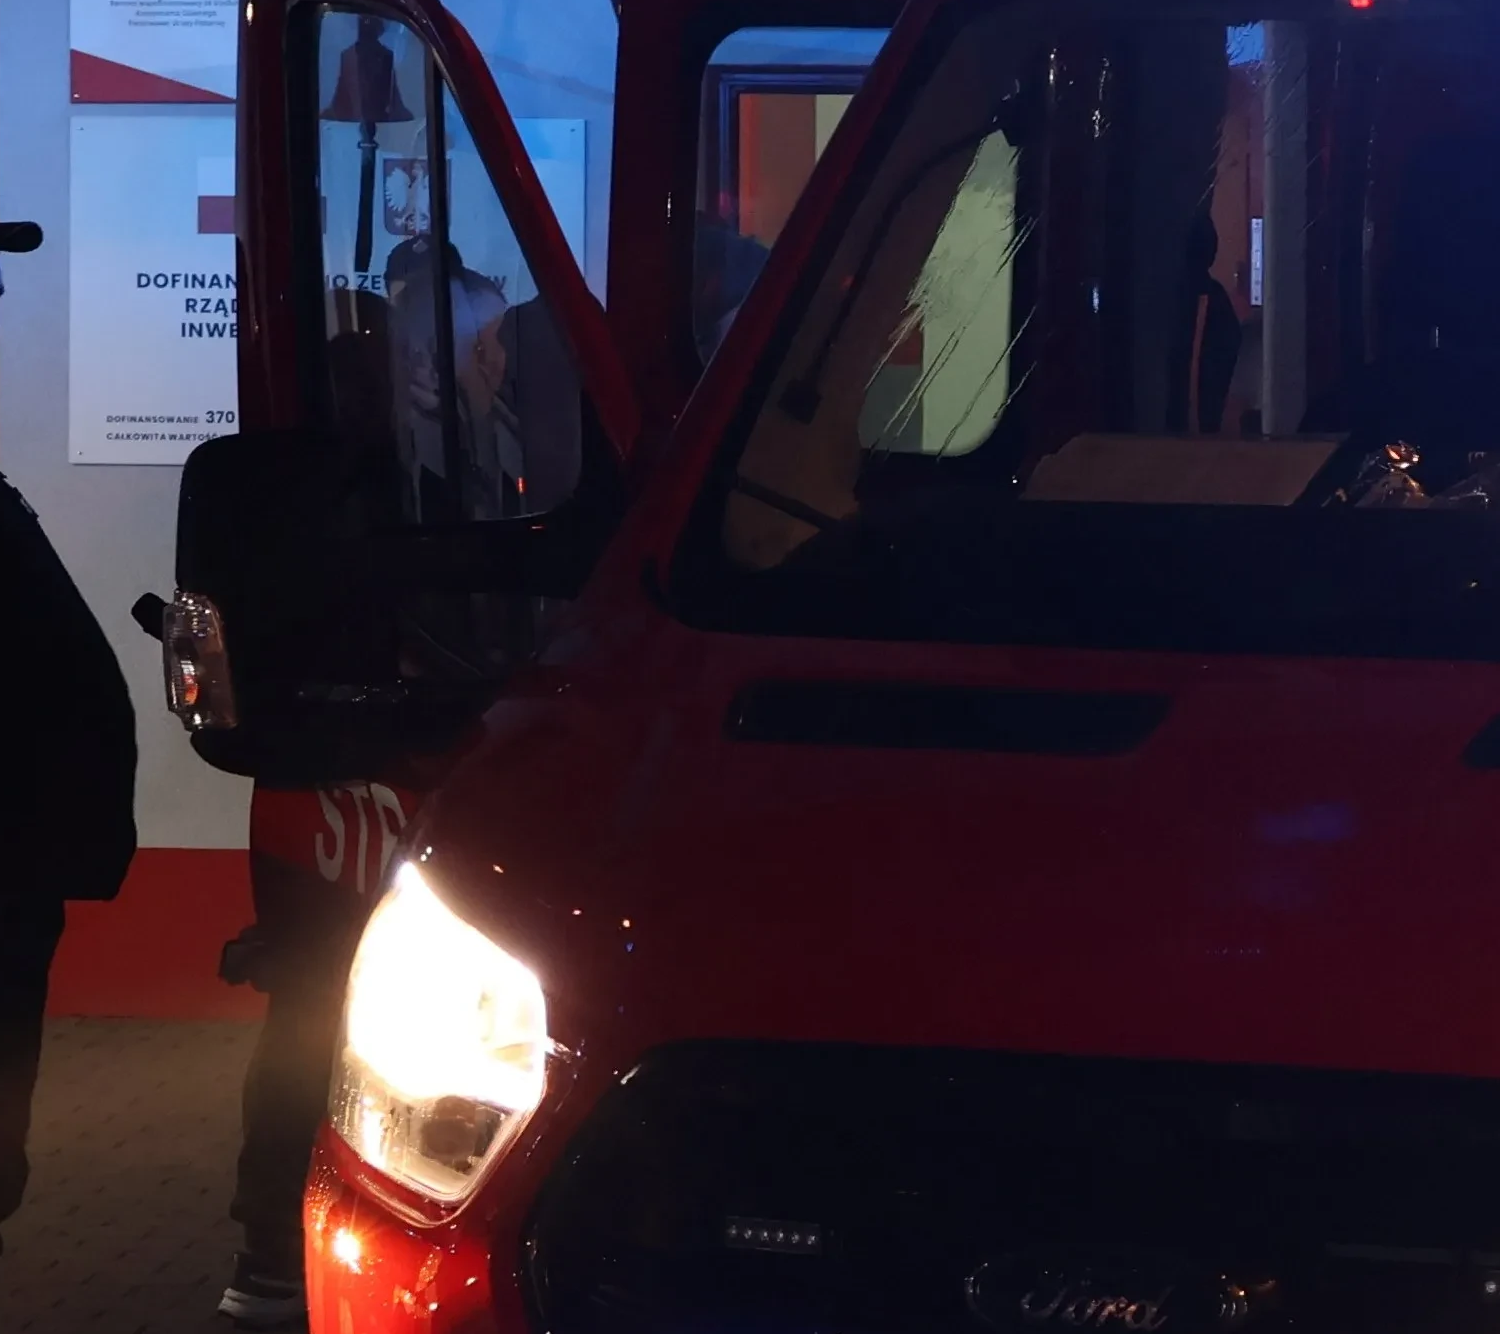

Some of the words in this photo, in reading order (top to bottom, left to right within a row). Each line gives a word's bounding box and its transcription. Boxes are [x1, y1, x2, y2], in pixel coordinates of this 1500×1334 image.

[136, 272, 239, 289] DOFINAN
[180, 322, 239, 338] INWE
[105, 415, 199, 424] DOFINANSOWANIE
[205, 410, 236, 424] 370
